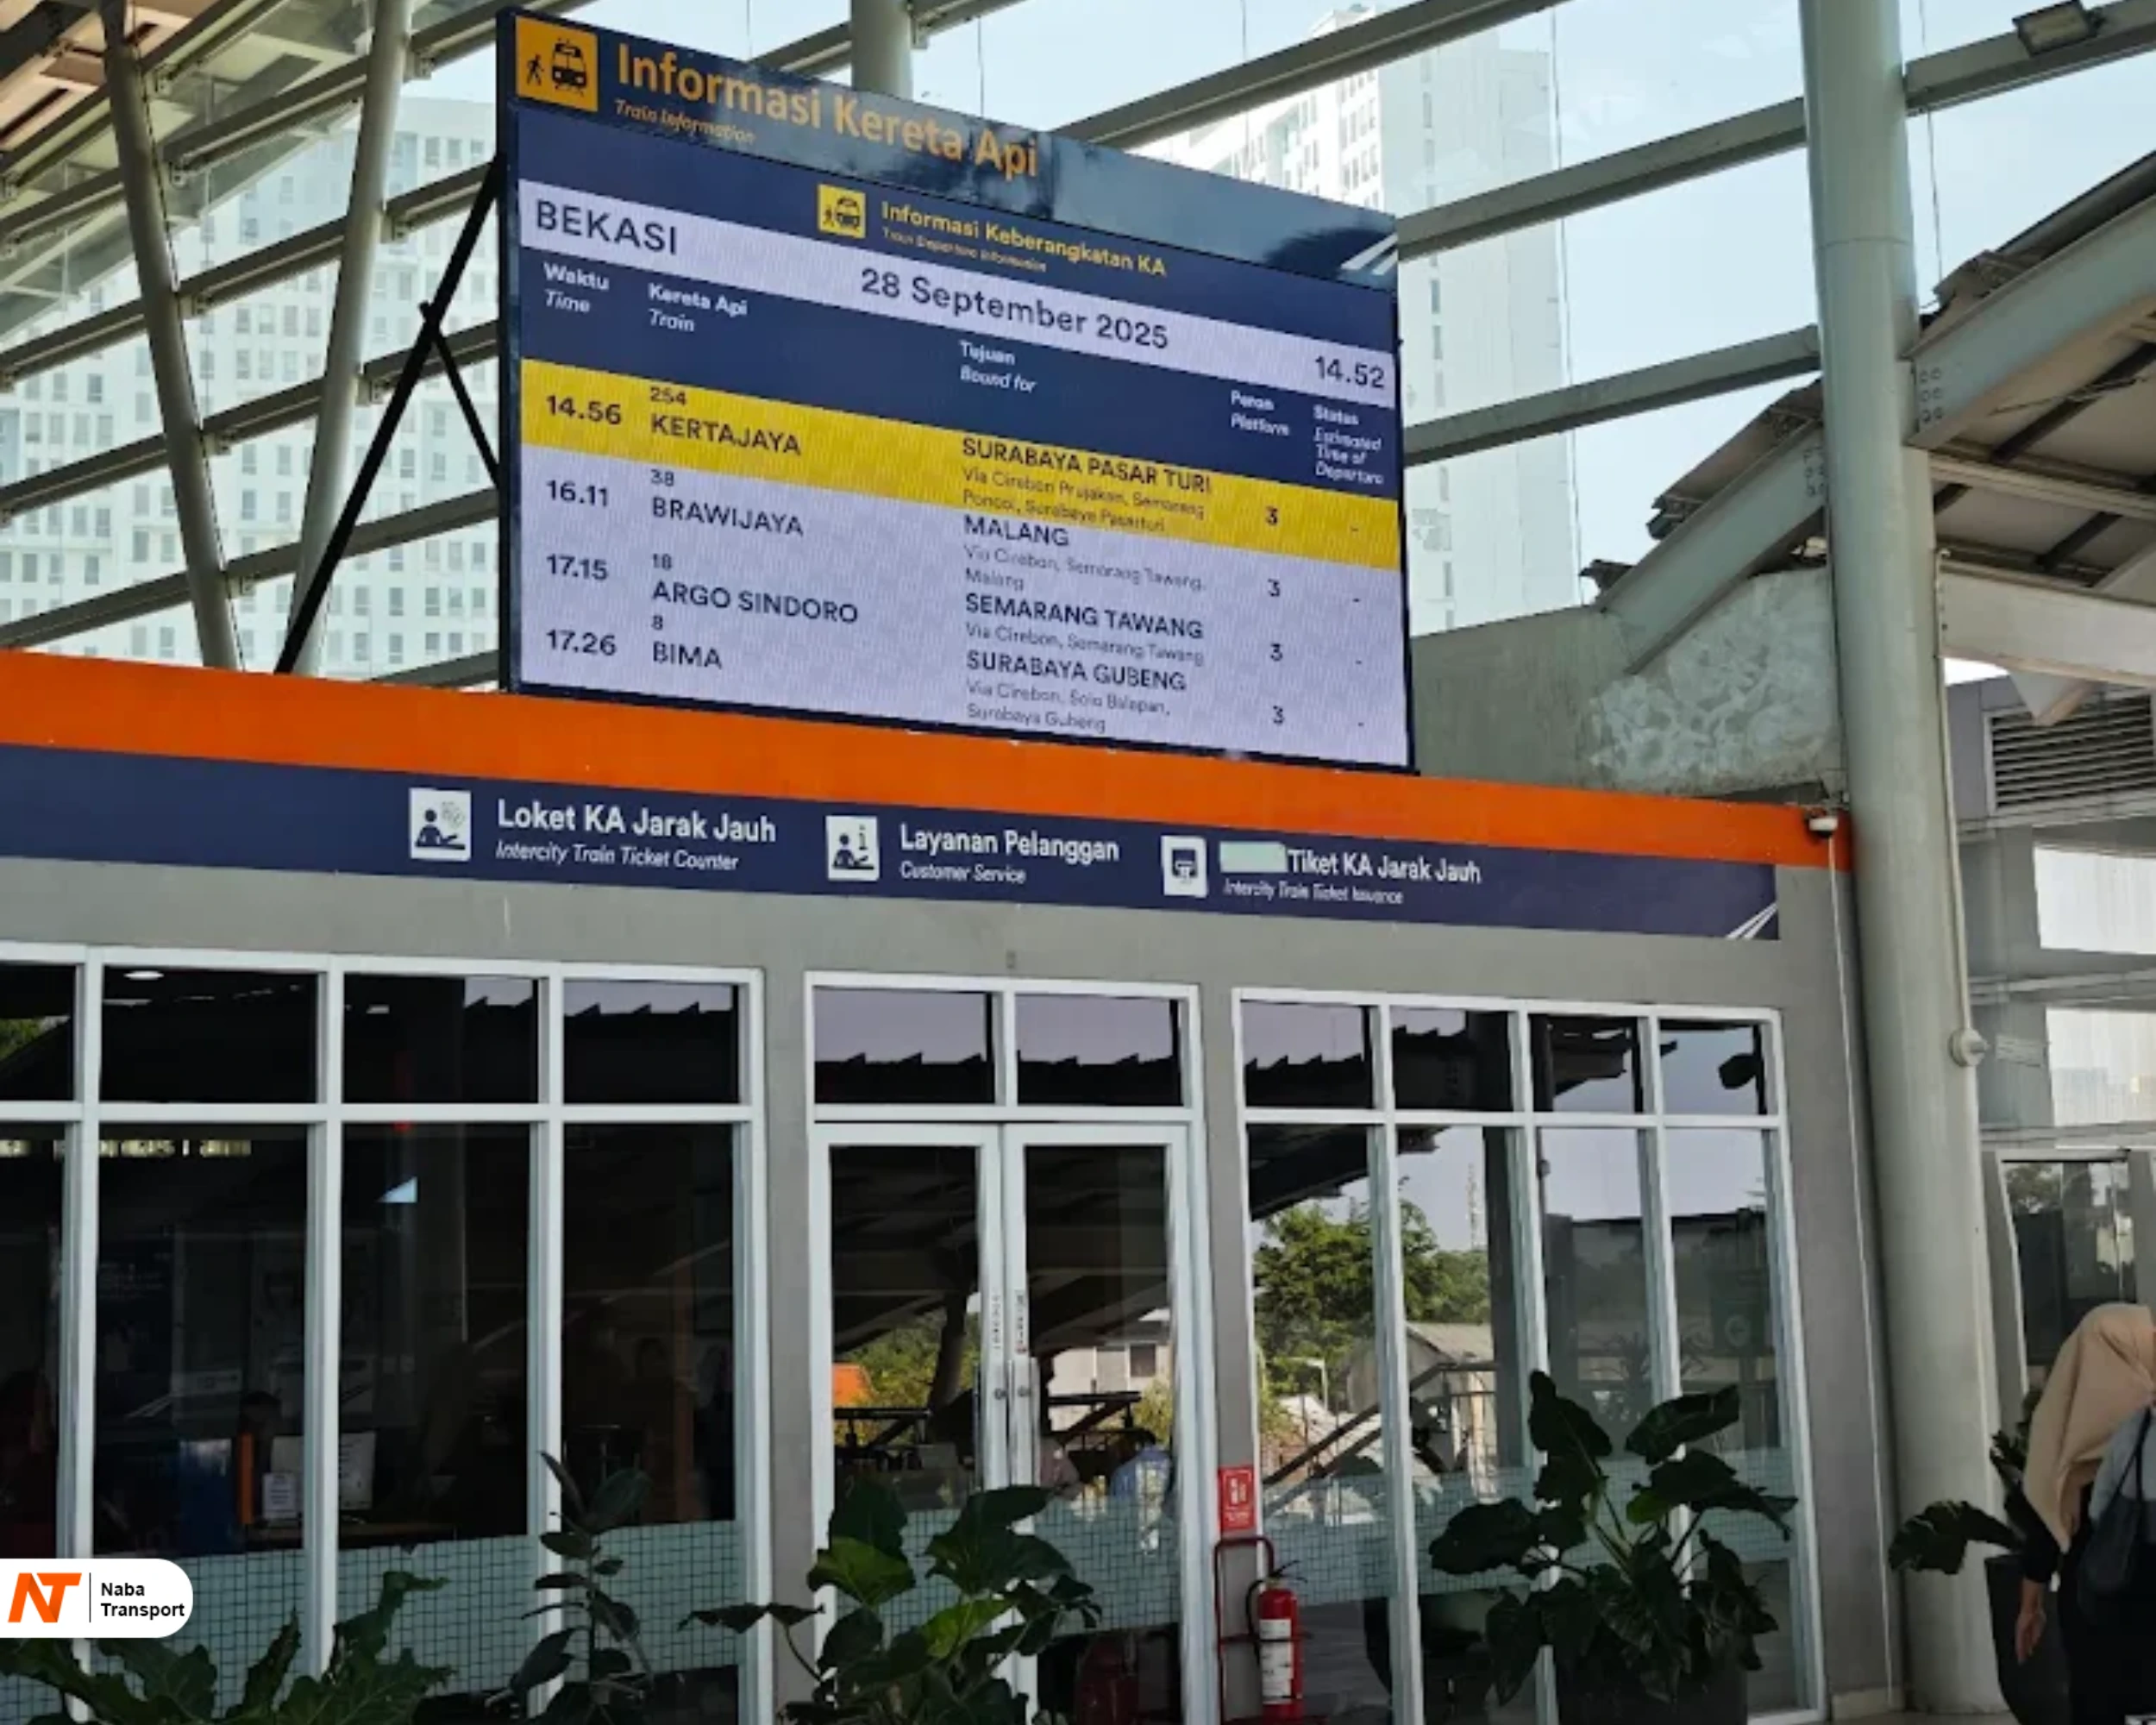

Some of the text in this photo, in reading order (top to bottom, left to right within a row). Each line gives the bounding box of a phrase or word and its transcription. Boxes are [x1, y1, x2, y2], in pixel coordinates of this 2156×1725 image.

[615, 99, 755, 144] Train Information
[618, 43, 1038, 181] Informasi Kereta Api
[537, 199, 677, 255] BEKASI
[881, 201, 1167, 276] Informasi Keberangkatan KA
[543, 262, 610, 291] Waktu
[544, 290, 590, 313] Time
[649, 283, 748, 318] Kereta Api
[862, 267, 1169, 348] 28 September 2025
[649, 309, 694, 332] Train
[960, 341, 1015, 366] Tujuan
[960, 365, 1037, 393] Bound for
[1313, 355, 1385, 388] 14.52
[546, 394, 623, 425] 14.56
[650, 386, 686, 405] 254
[1231, 412, 1289, 436] Platform
[1313, 404, 1359, 425] Status
[650, 412, 802, 455] KERTAJAYA
[963, 436, 1213, 493] SURABAYA PASAR TURI
[1351, 451, 1368, 465] of
[650, 468, 675, 486] 38
[546, 480, 609, 507] 16.11
[964, 468, 987, 485] Via
[993, 471, 1055, 493] Cirebon
[1132, 492, 1205, 521] Semarang
[652, 496, 805, 536] BRAWIJAYA
[1265, 506, 1278, 526] 3
[964, 514, 1069, 547] MALANG
[652, 553, 672, 571] 18
[964, 544, 990, 561] Via
[546, 553, 609, 581] 17.15
[965, 567, 1025, 592] Malang
[1268, 578, 1281, 597] 3
[652, 580, 858, 624] ARGO SINDORO
[966, 592, 1204, 639] SEMARANG TAWANG
[651, 615, 664, 630] 8
[966, 622, 990, 639] Via
[546, 629, 617, 656] 17.26
[652, 641, 724, 670] BIMA
[1269, 643, 1283, 662] 3
[967, 649, 1188, 691] SURABAYA GUBENG
[966, 680, 993, 697] Via
[1069, 689, 1103, 707] Solo
[967, 703, 1106, 733] Surabaya Gubeng
[1272, 706, 1285, 725] 3
[498, 798, 776, 843] Loket KA Jarak Jauh
[496, 840, 738, 871] Intercity Train Ticket Counter
[900, 822, 1119, 865] Layanan Pelanggan
[899, 861, 1026, 885] Customer Service
[1288, 849, 1482, 884] Tiket KA Jarak Jauh
[1223, 878, 1275, 900] Intercity
[1313, 882, 1349, 901] Ticket
